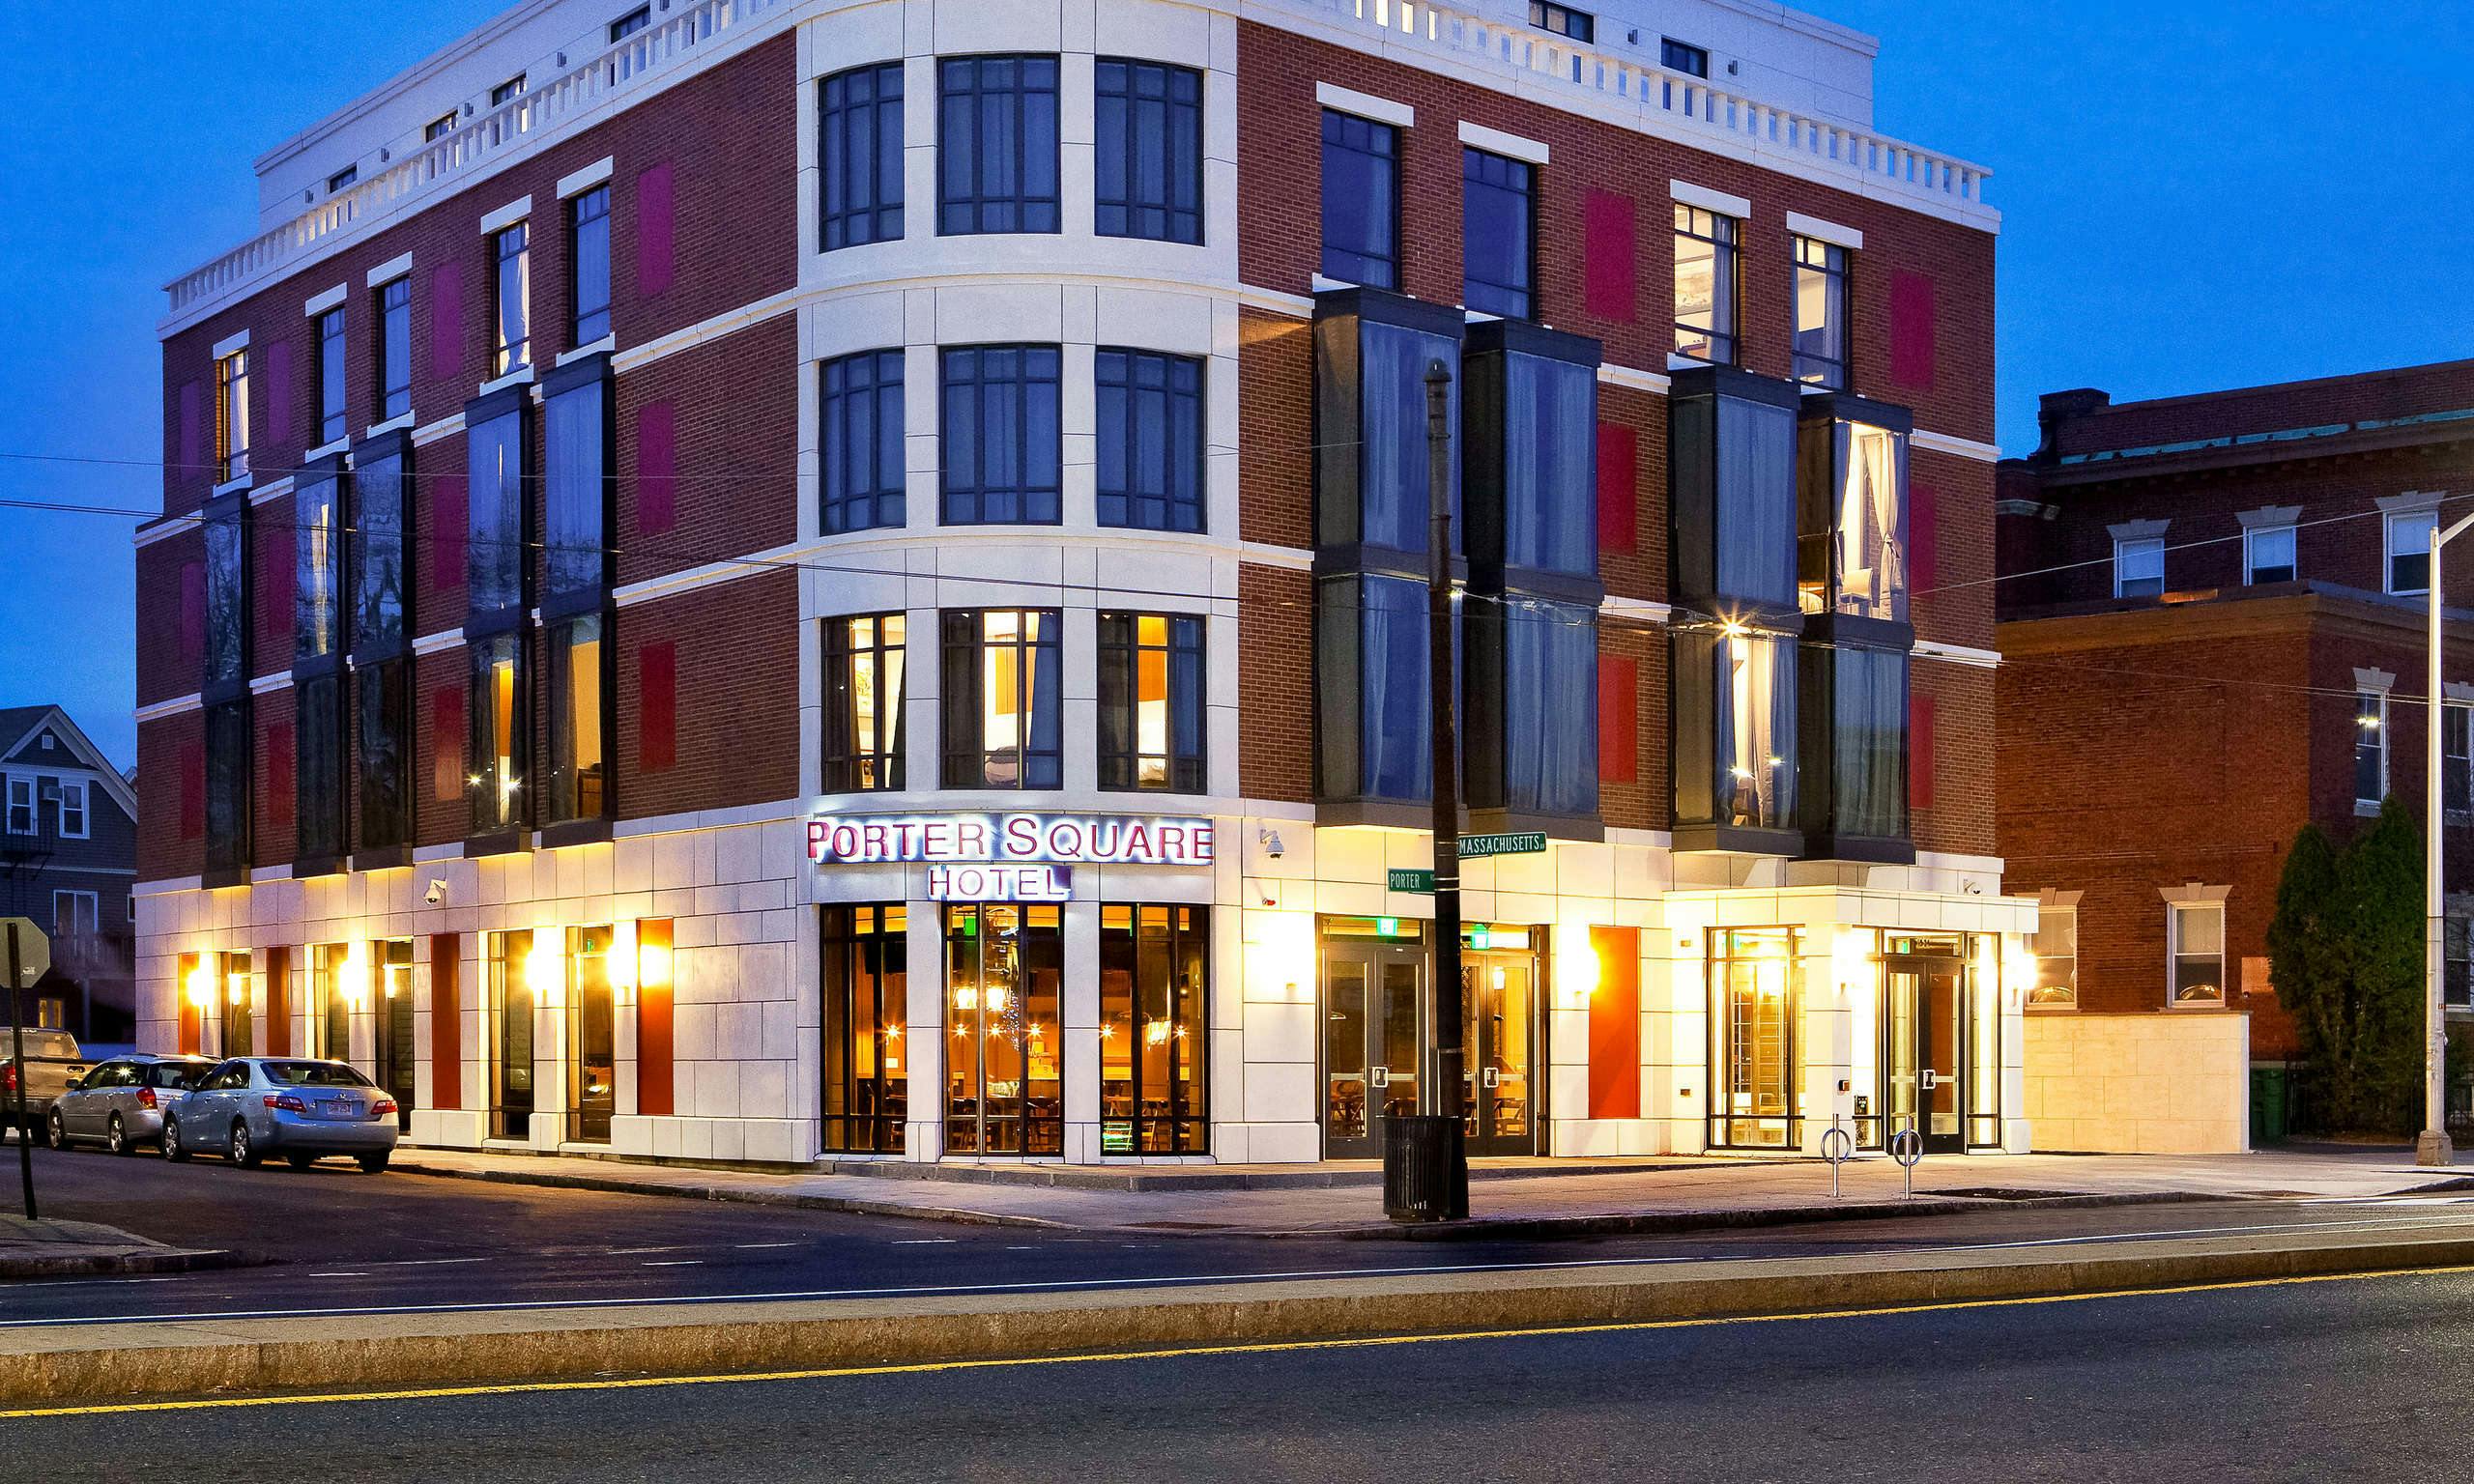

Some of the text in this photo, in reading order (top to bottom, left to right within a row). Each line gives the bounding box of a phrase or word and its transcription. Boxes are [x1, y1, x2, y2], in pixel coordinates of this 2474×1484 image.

[808, 817, 1215, 860] PORTER SQUARE
[1459, 835, 1539, 854] MASSACHUSETTS
[930, 869, 1066, 896] HOTEL
[1390, 872, 1420, 889] PORTER
